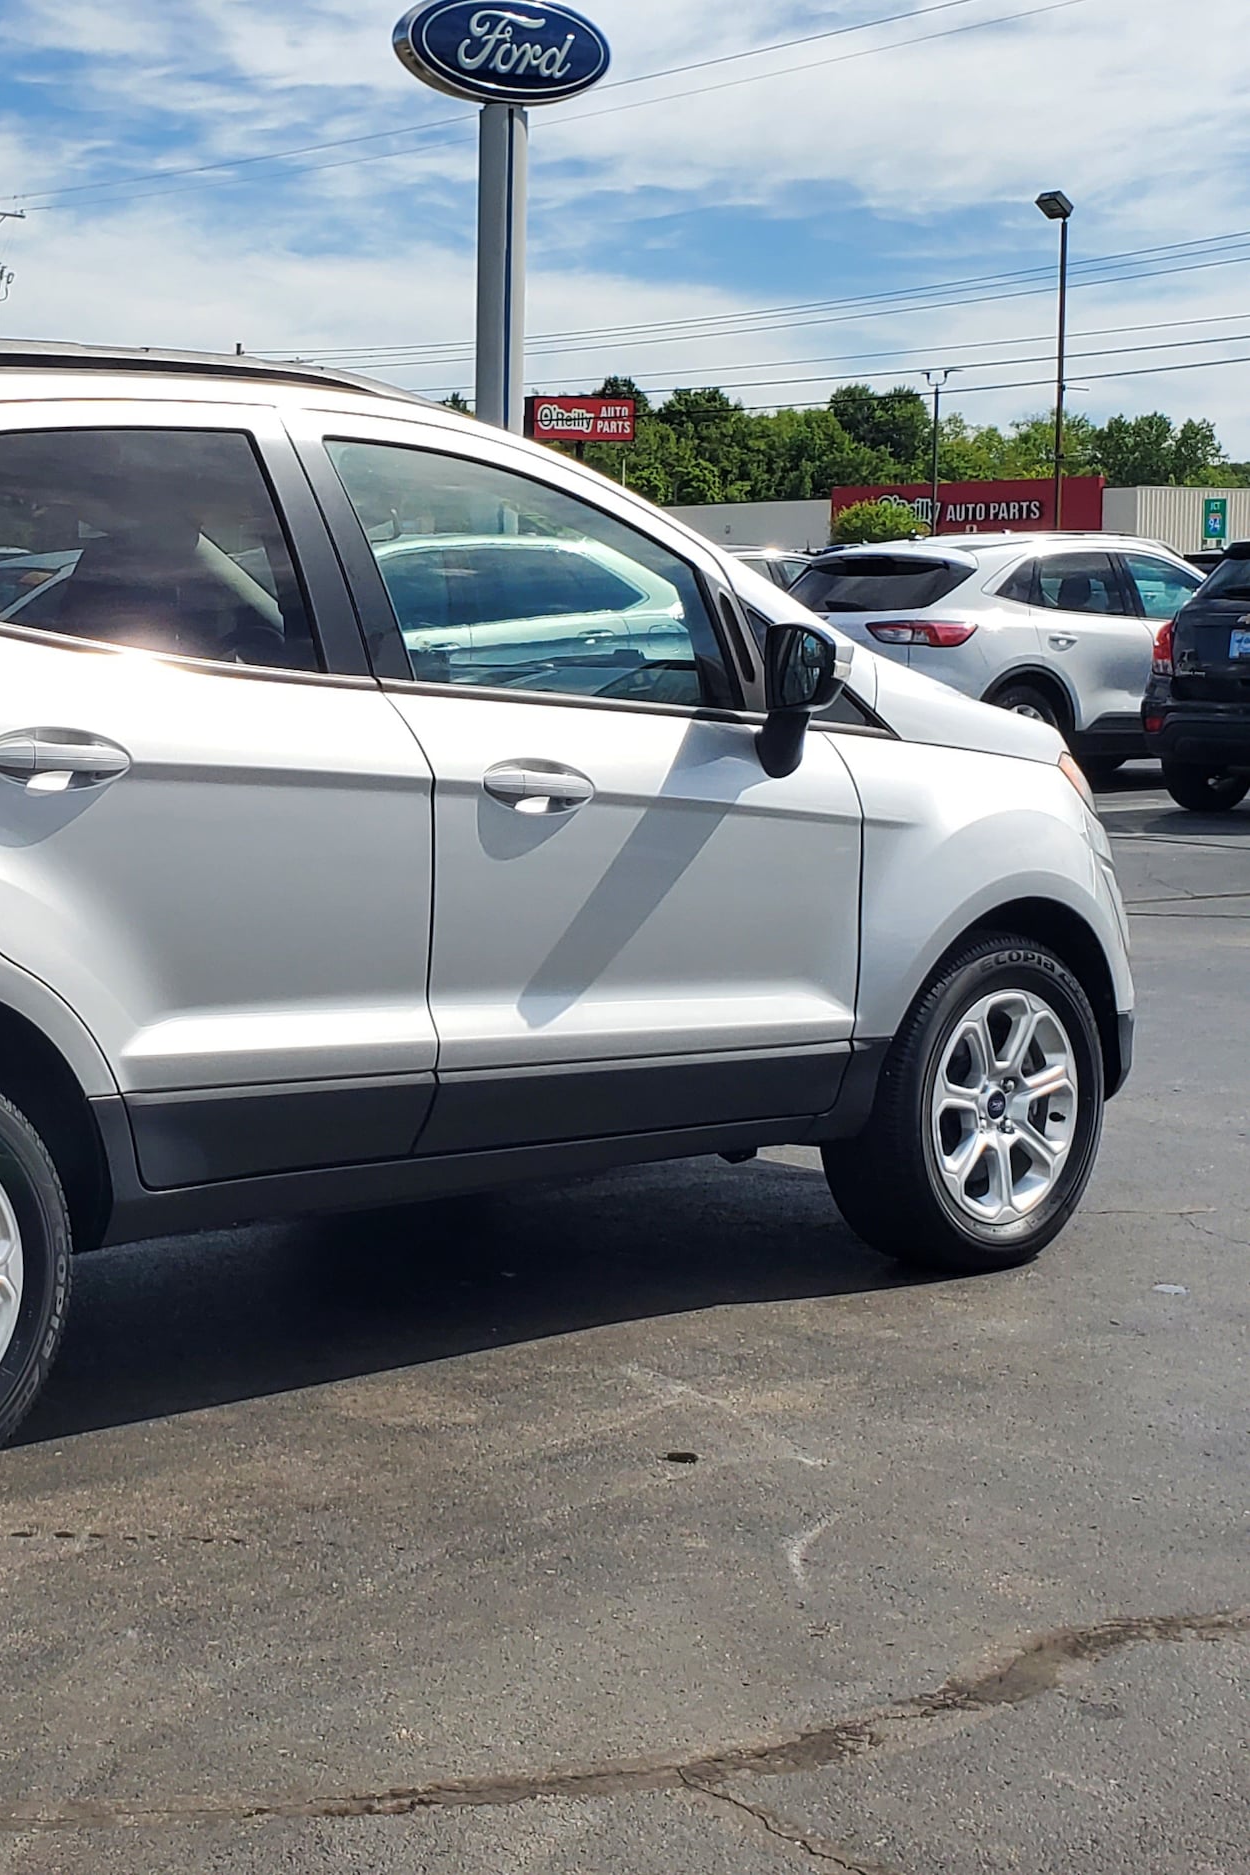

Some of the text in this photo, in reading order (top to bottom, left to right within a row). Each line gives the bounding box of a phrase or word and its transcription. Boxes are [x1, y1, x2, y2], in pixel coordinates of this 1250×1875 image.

[457, 9, 575, 79] Ford
[537, 404, 595, 433] O'Reilly
[600, 406, 629, 419] AUTO
[597, 420, 631, 434] PARTS
[946, 503, 986, 522] AUTO
[989, 501, 1040, 521] PARTS
[1208, 518, 1221, 530] 94
